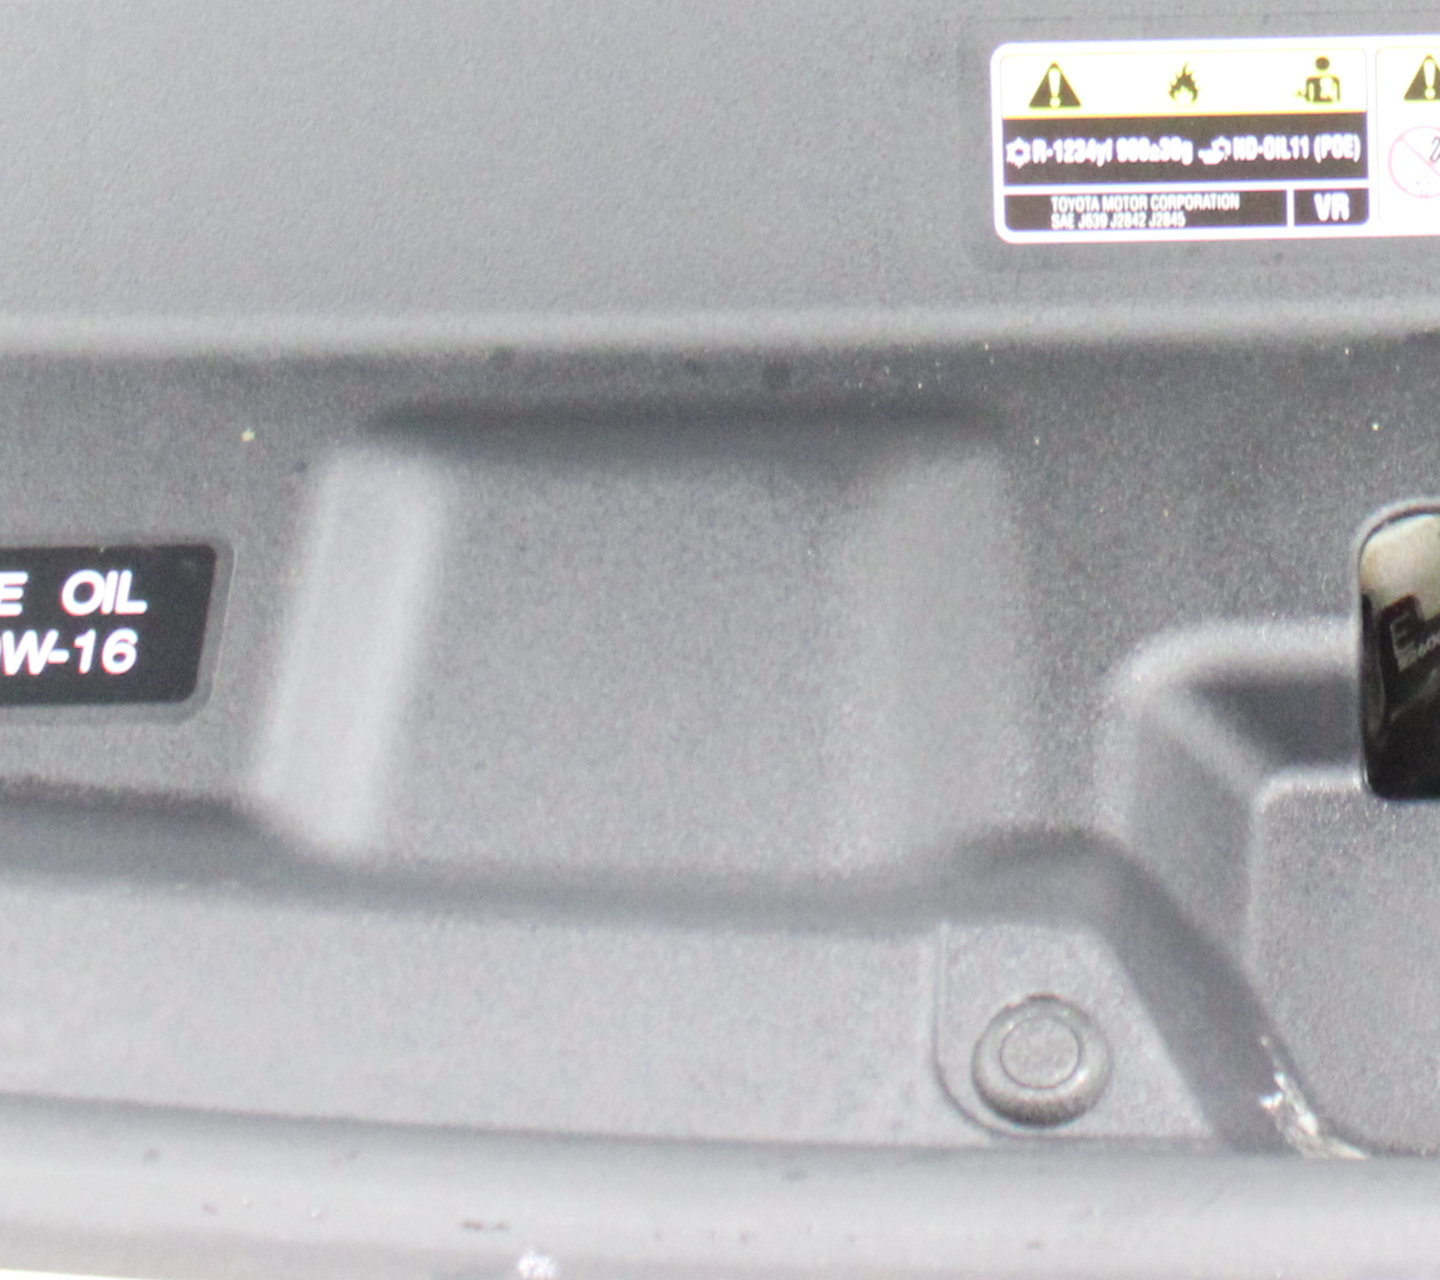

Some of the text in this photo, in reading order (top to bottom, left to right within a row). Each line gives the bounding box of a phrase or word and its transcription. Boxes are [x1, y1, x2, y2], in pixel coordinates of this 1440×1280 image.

[1313, 132, 1361, 164] (POE)
[1051, 192, 1241, 213] TOYOTA MOTOR CORPORATION
[1313, 192, 1350, 222] VR
[1050, 210, 1186, 230] SAE J639 J2842 J2845
[60, 569, 148, 617] OIL
